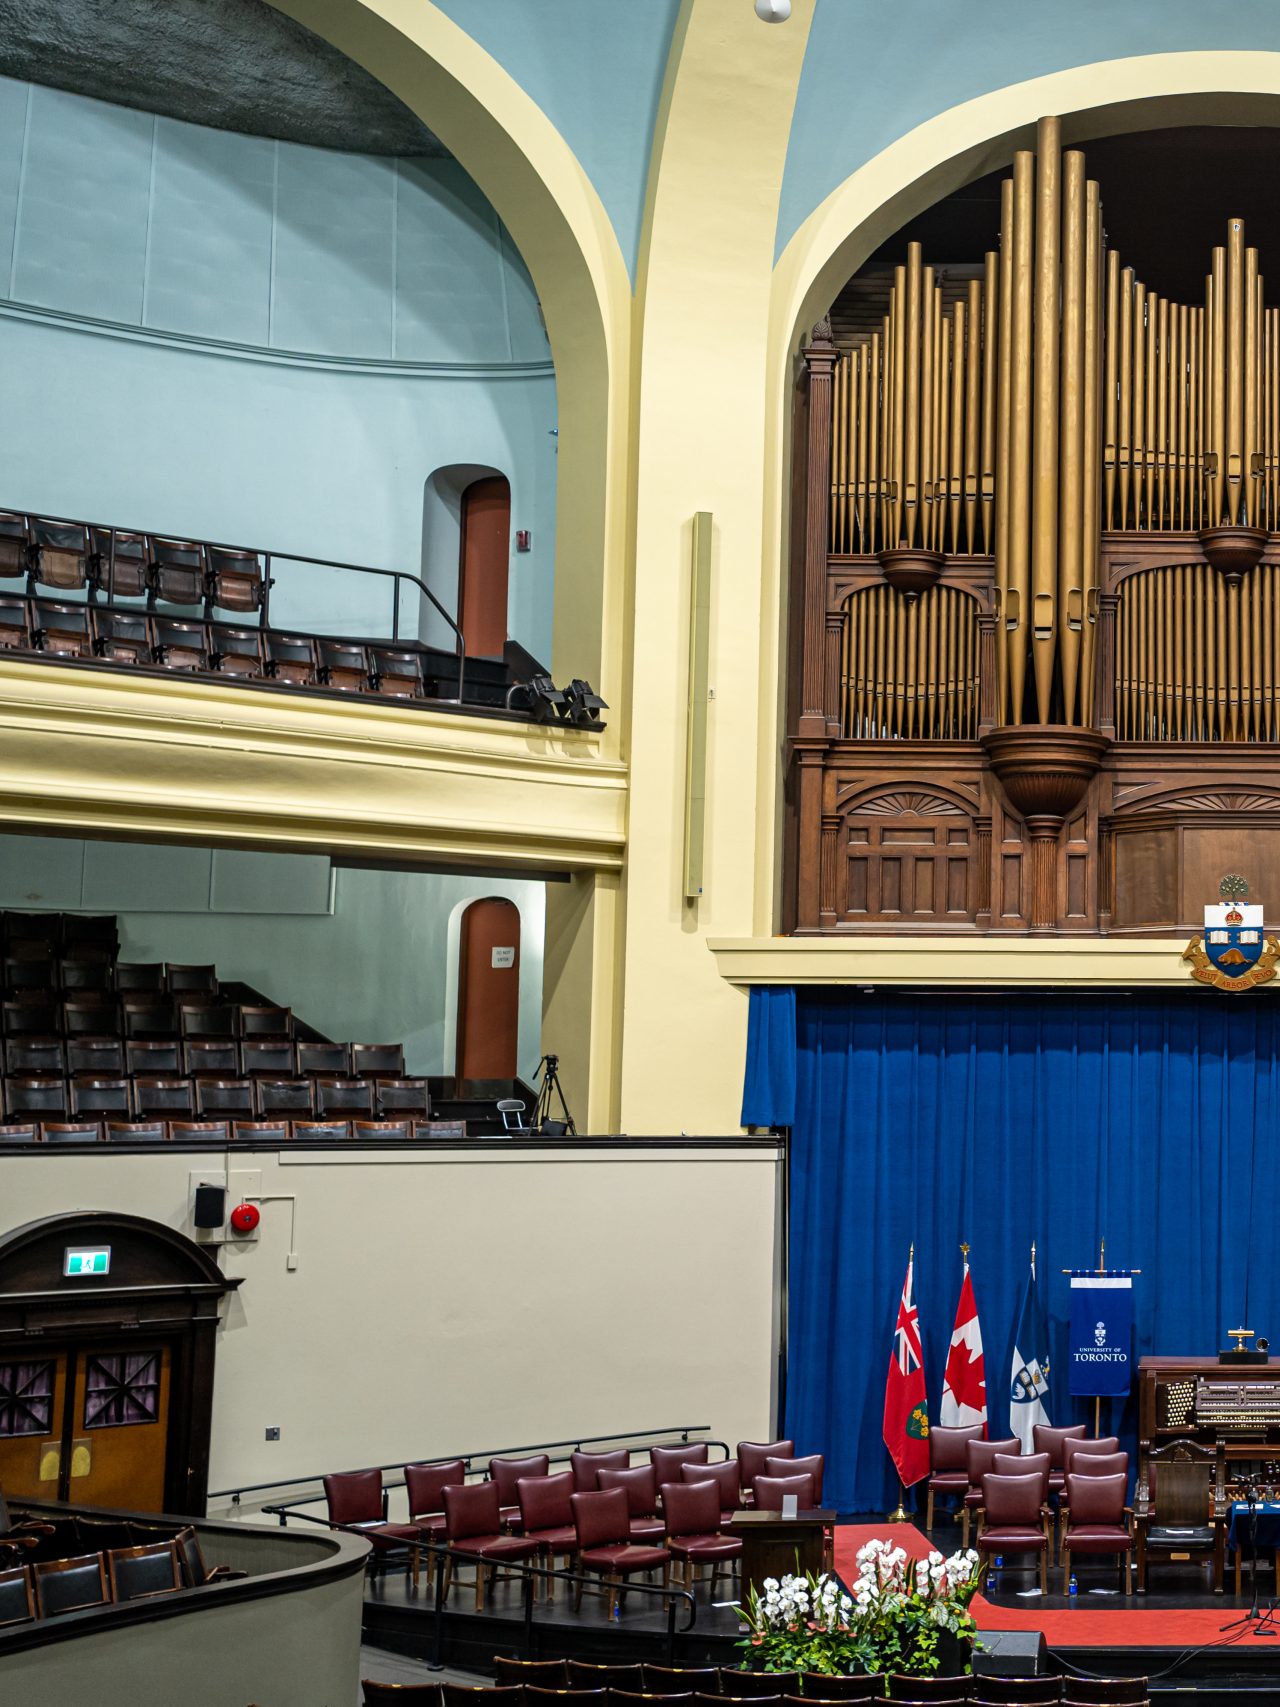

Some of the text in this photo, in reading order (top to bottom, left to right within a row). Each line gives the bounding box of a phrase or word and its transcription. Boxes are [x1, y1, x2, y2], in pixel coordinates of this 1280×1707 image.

[1196, 968, 1218, 980] VELUT
[1222, 980, 1249, 989] ARBOR
[1073, 1353, 1127, 1362] TORONTO
